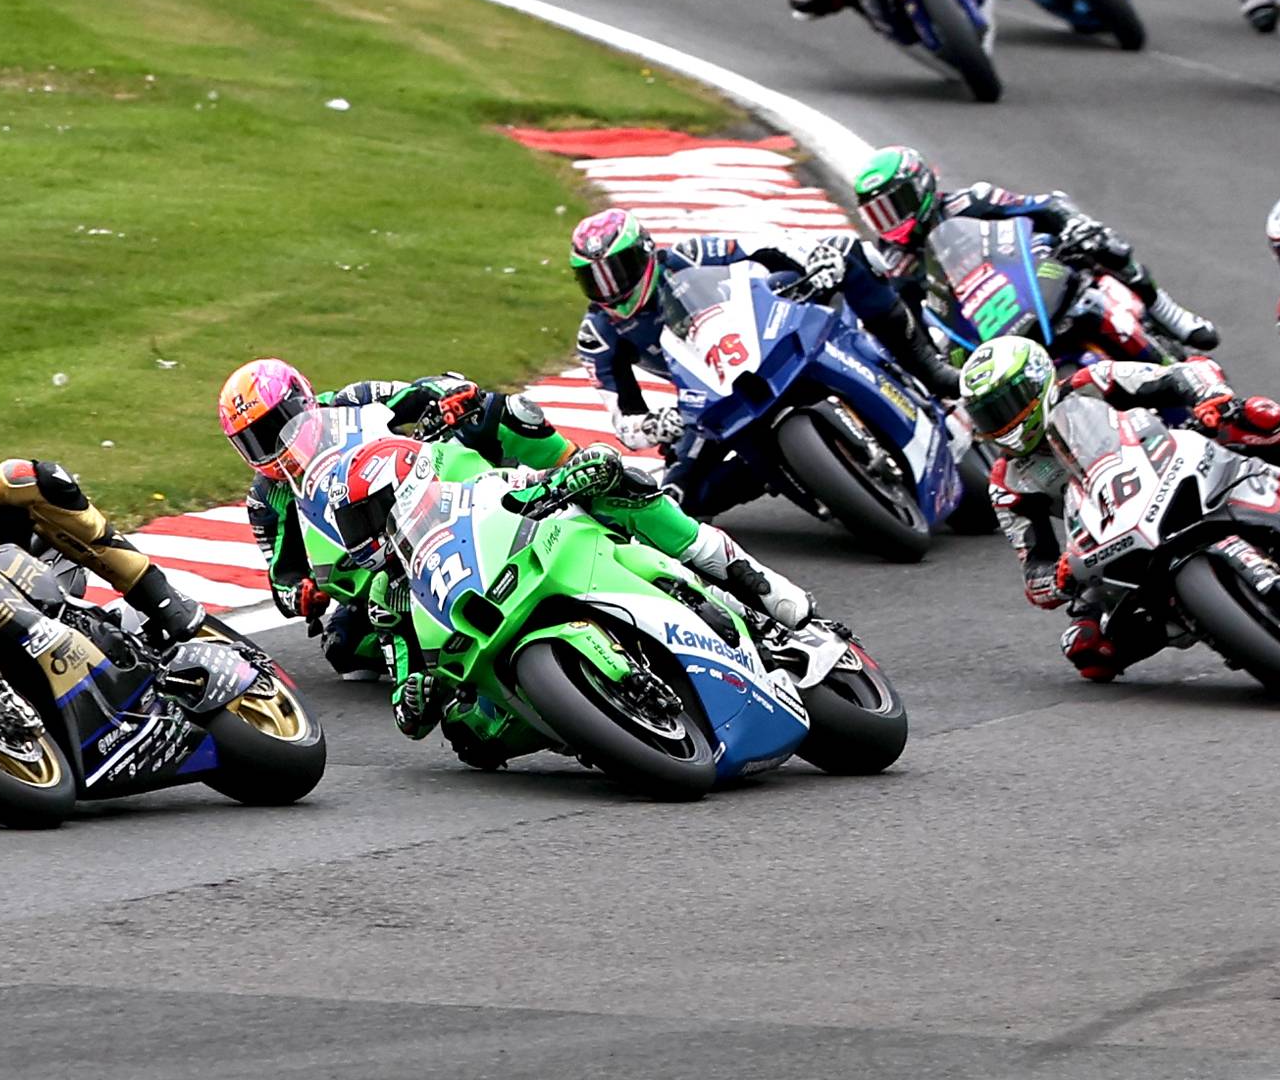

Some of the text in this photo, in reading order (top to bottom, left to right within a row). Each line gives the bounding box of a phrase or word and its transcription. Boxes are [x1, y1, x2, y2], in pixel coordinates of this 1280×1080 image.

[974, 282, 1021, 342] 22
[1156, 457, 1185, 503] OXFORD
[1097, 535, 1136, 560] OXFORD
[430, 551, 472, 612] 11
[51, 645, 87, 676] OMG
[663, 622, 756, 674] Kawasaki
